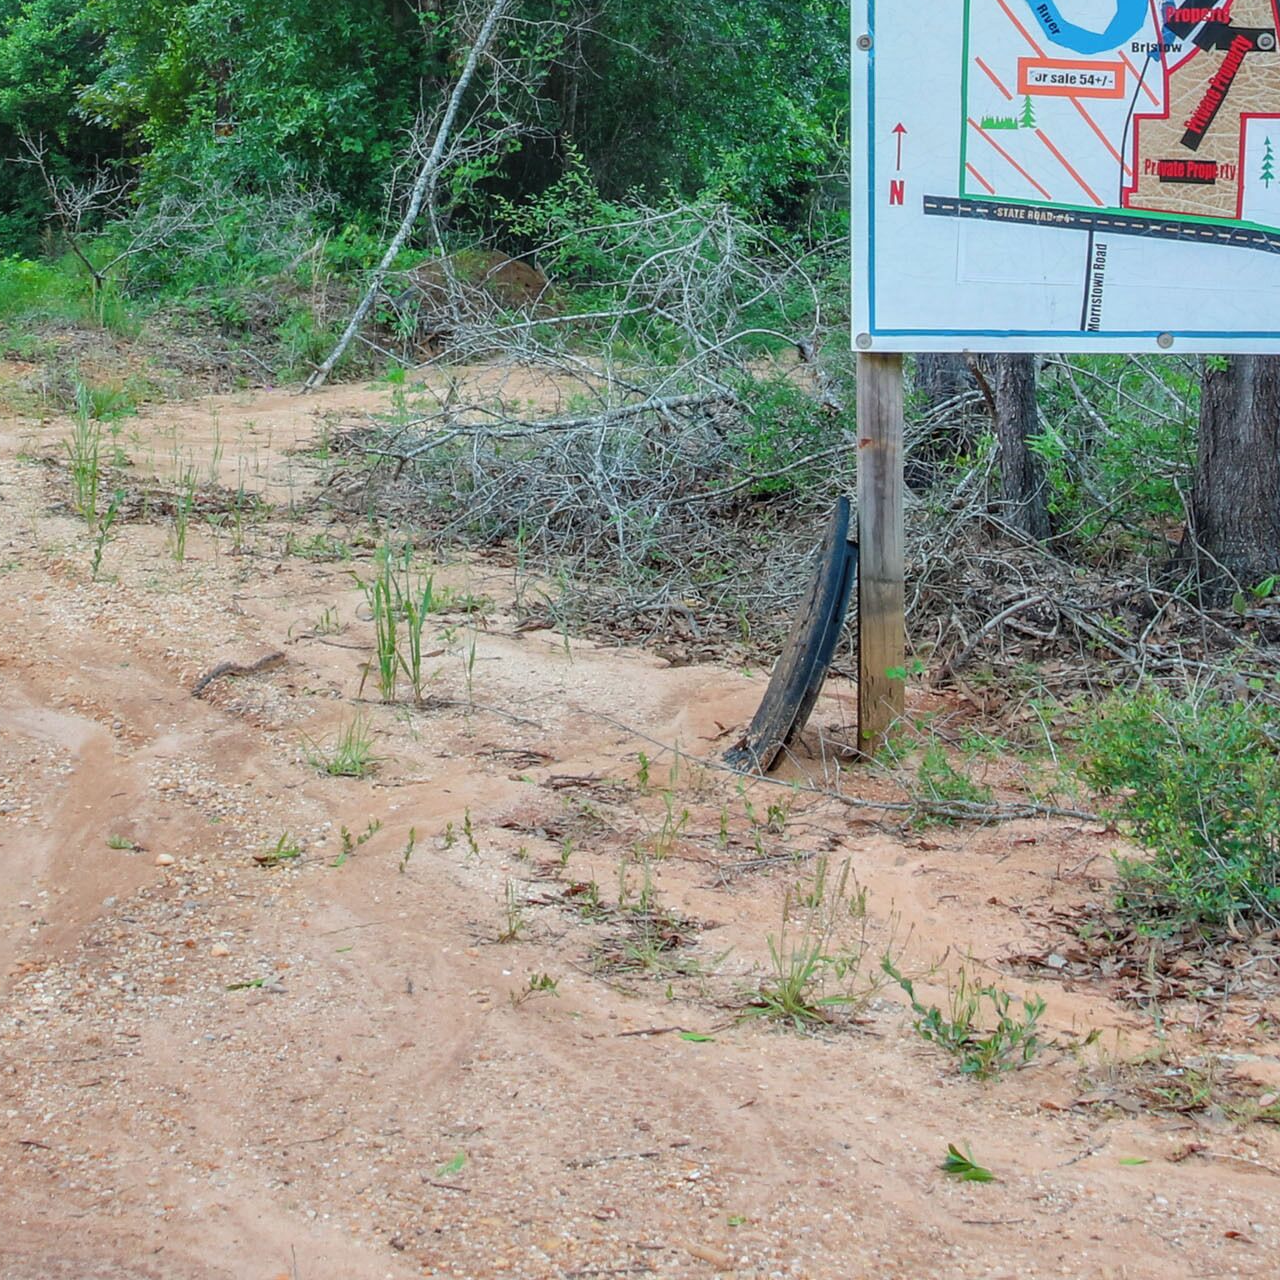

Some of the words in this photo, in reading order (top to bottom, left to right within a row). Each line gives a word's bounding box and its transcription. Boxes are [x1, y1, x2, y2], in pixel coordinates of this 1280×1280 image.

[1036, 3, 1061, 36] River
[1165, 6, 1230, 24] Property
[1131, 42, 1183, 53] Bristow
[1050, 73, 1077, 85] sale
[1144, 158, 1186, 177] Private
[1189, 161, 1236, 180] Property
[889, 180, 905, 206] N
[996, 207, 1025, 219] STATE
[1093, 243, 1107, 271] Road
[1087, 272, 1105, 333] Morristown
